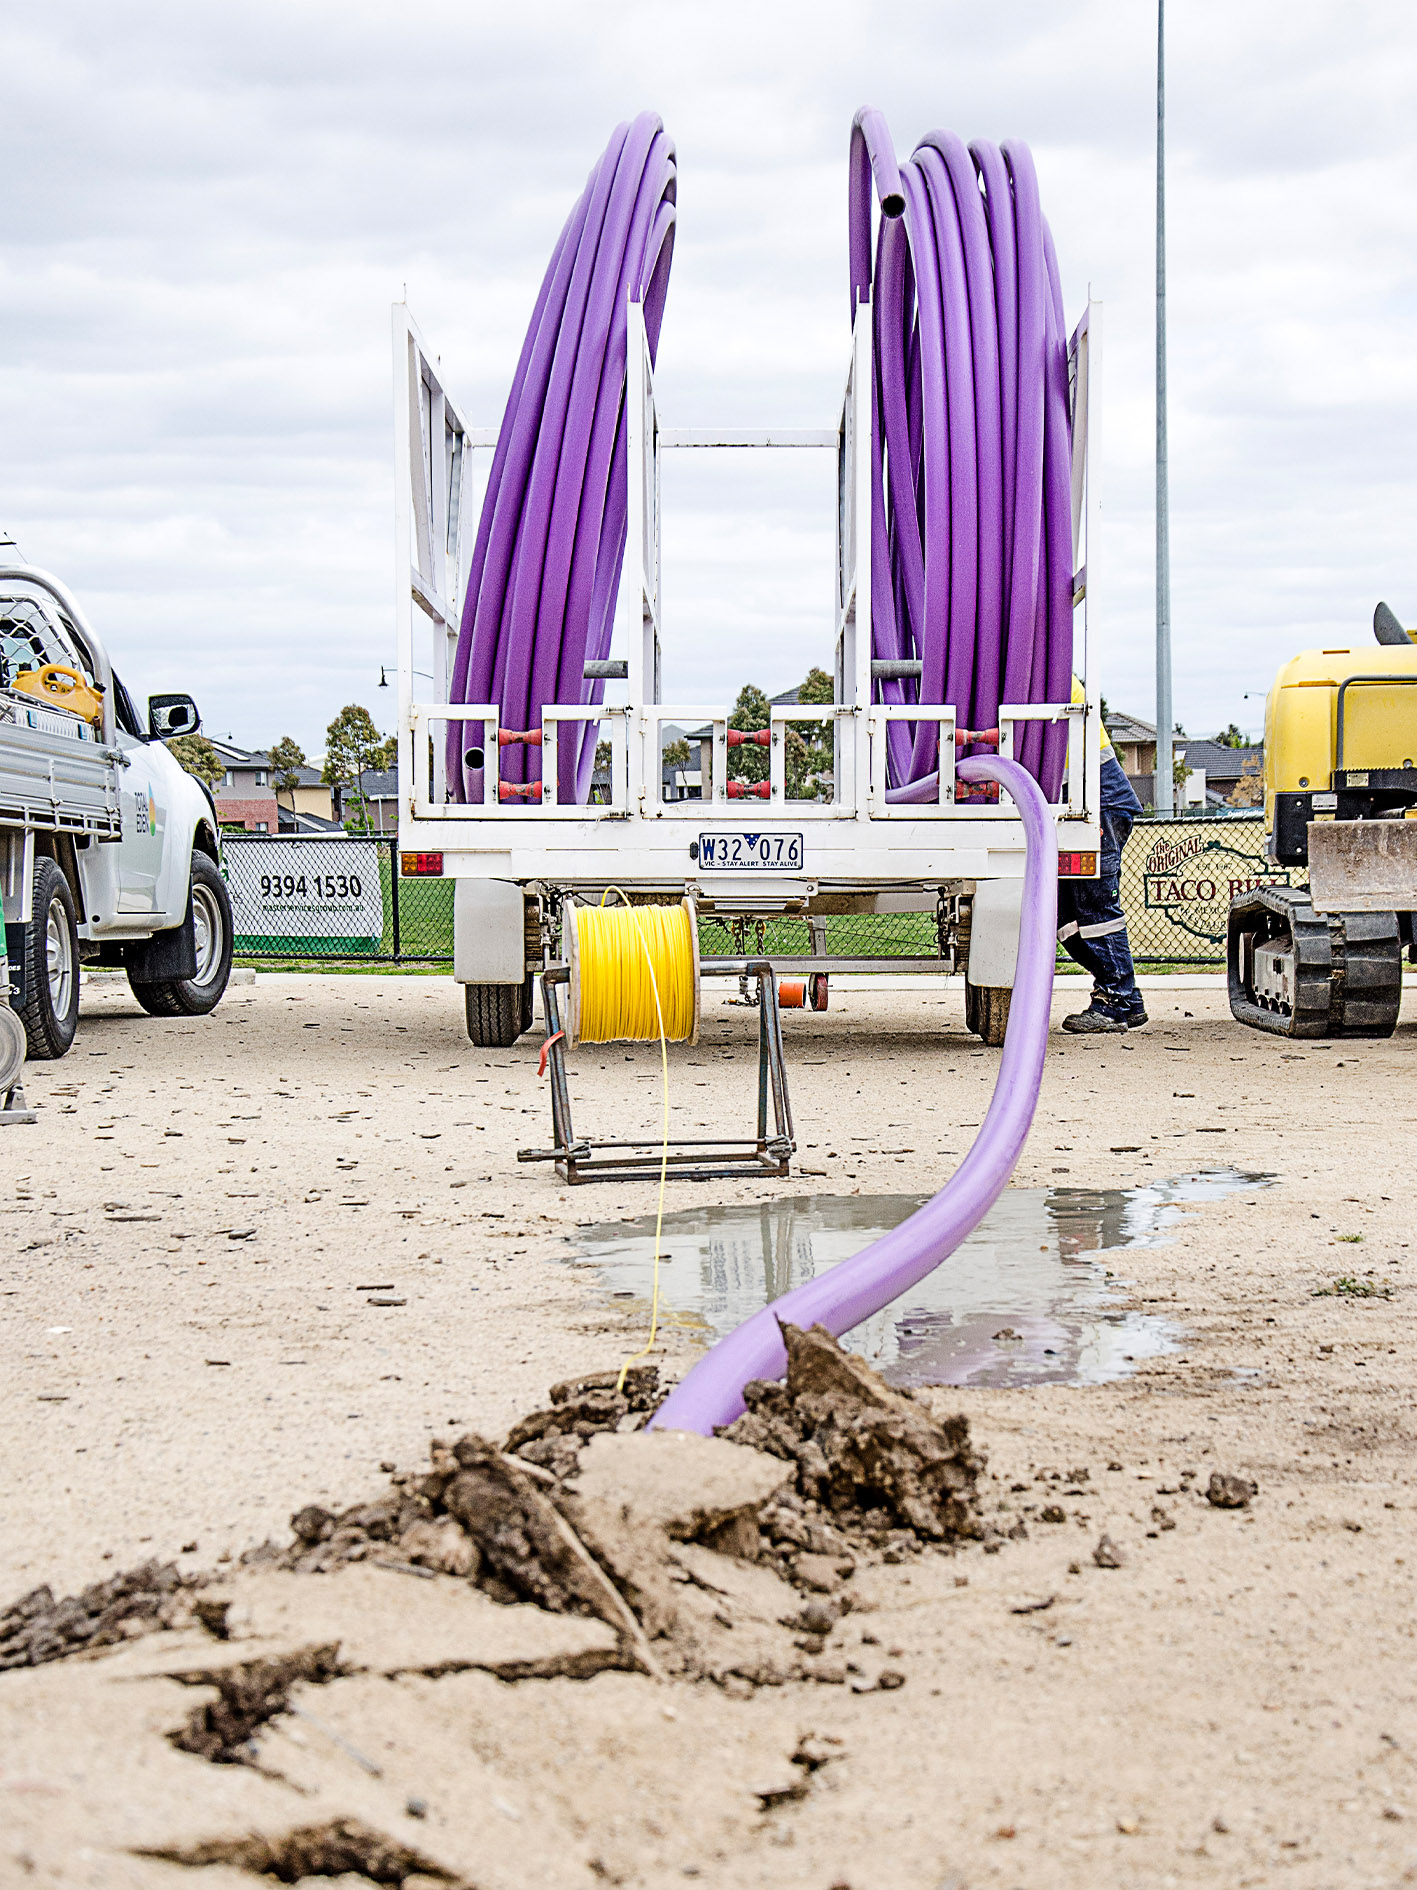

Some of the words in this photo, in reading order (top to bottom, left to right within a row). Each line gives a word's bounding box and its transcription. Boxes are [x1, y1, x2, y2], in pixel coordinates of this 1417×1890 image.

[136, 814, 149, 833] EDEN
[702, 839, 741, 860] W32
[760, 839, 798, 860] 076
[1149, 838, 1201, 872] ORIGINAL
[260, 874, 307, 898] 9394
[313, 874, 362, 898] 1530
[1151, 879, 1216, 900] TACO
